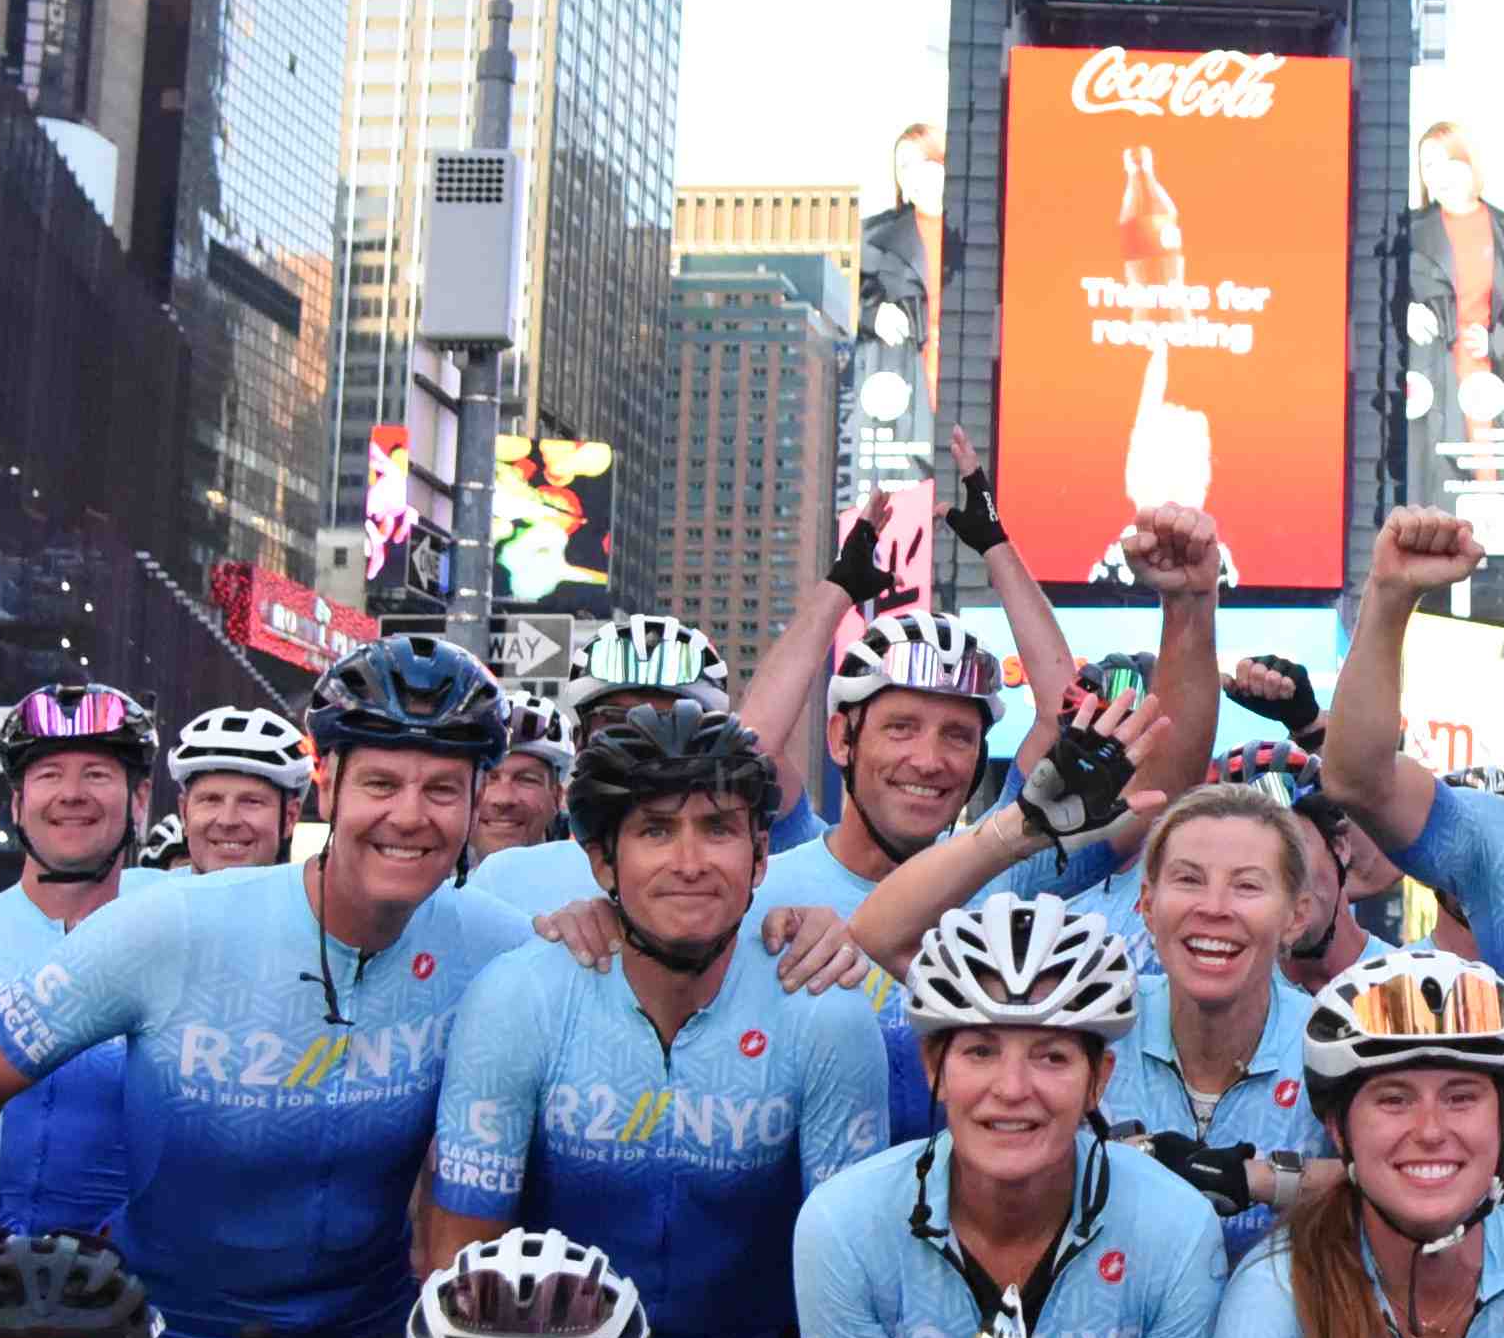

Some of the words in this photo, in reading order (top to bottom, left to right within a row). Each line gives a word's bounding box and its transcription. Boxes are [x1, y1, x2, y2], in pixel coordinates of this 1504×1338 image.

[1081, 276, 1211, 312] Thanks
[1217, 278, 1271, 311] for
[1092, 315, 1254, 353] recycling
[489, 635, 541, 662] WAY
[219, 1090, 269, 1109] RIDE
[276, 1091, 315, 1109] FOR
[325, 1081, 412, 1107] CAMPFIRE
[543, 1083, 794, 1150] R2//NYC
